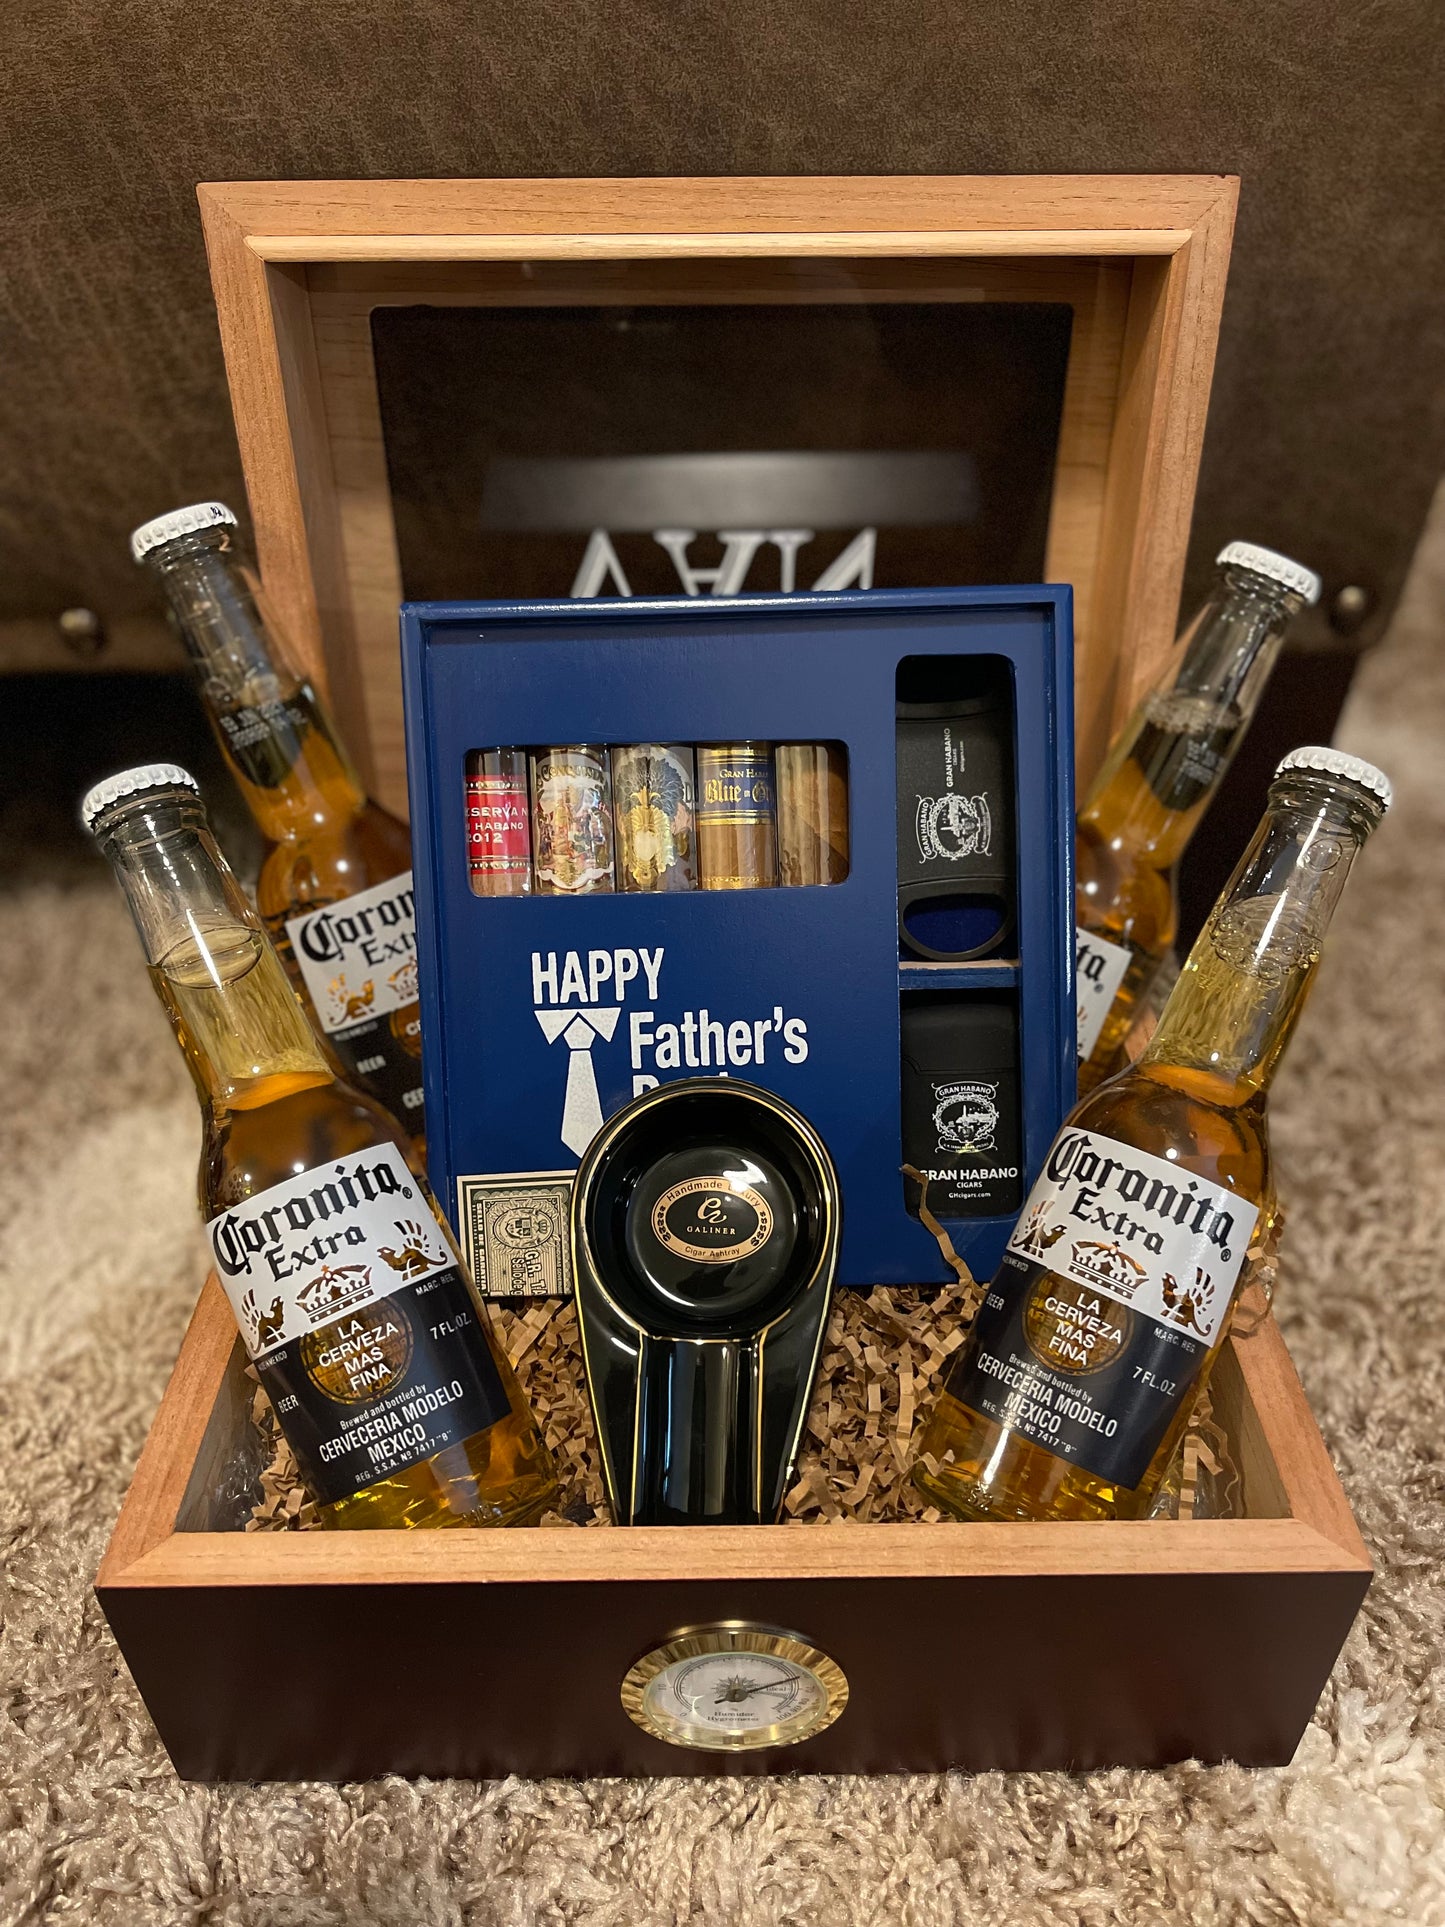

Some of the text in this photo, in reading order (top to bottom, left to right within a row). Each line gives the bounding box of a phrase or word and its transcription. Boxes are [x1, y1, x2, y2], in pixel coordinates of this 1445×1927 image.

[944, 728, 954, 787] GRAN HABANO
[704, 778, 742, 804] Blue
[475, 822, 524, 831] HABANO
[920, 802, 932, 856] GRAN HABANO
[531, 947, 664, 1005] HAPPY
[629, 1006, 809, 1069] Father's
[939, 1085, 991, 1096] GRAN HABANO
[956, 1181, 983, 1189] CIGARS
[960, 1167, 1018, 1180] HABANO
[666, 1180, 723, 1201] Handmade
[948, 1191, 991, 1200] GHcigars.com
[1046, 1132, 1235, 1249] Coronita
[212, 1162, 401, 1277] Coronita
[476, 1203, 484, 1231] SELLO
[686, 1225, 736, 1235] GALINER
[1069, 1187, 1164, 1256] Extra
[264, 1226, 367, 1282] Extra
[685, 1245, 740, 1258] Cigar Ashtray
[511, 1258, 525, 1278] Sello
[415, 1278, 440, 1295] MARC.
[1076, 1292, 1100, 1315] LA
[337, 1319, 364, 1340] LA
[1044, 1297, 1122, 1344] CERVEZA
[1056, 1320, 1096, 1349] MAS
[318, 1322, 399, 1367] CERVEZA
[1153, 1326, 1180, 1346] MARC.
[344, 1346, 384, 1375] MAS
[1048, 1336, 1088, 1366] FINA
[350, 1362, 392, 1391] FINA
[1132, 1365, 1143, 1379] 7
[977, 1352, 1118, 1438] CERVECERIA MODELO
[1051, 1374, 1082, 1397] bottled
[1081, 1390, 1093, 1404] by
[277, 1394, 299, 1414] BEER
[339, 1382, 427, 1430] Brewed and bottled by
[1003, 1391, 1061, 1433] MEXICO
[319, 1380, 464, 1463] CERVECERIA MODELO
[982, 1399, 997, 1414] REG.
[1037, 1430, 1060, 1447] 7417
[366, 1423, 426, 1464] MEXICO
[354, 1470, 373, 1484] REG.
[414, 1437, 436, 1456] 7417
